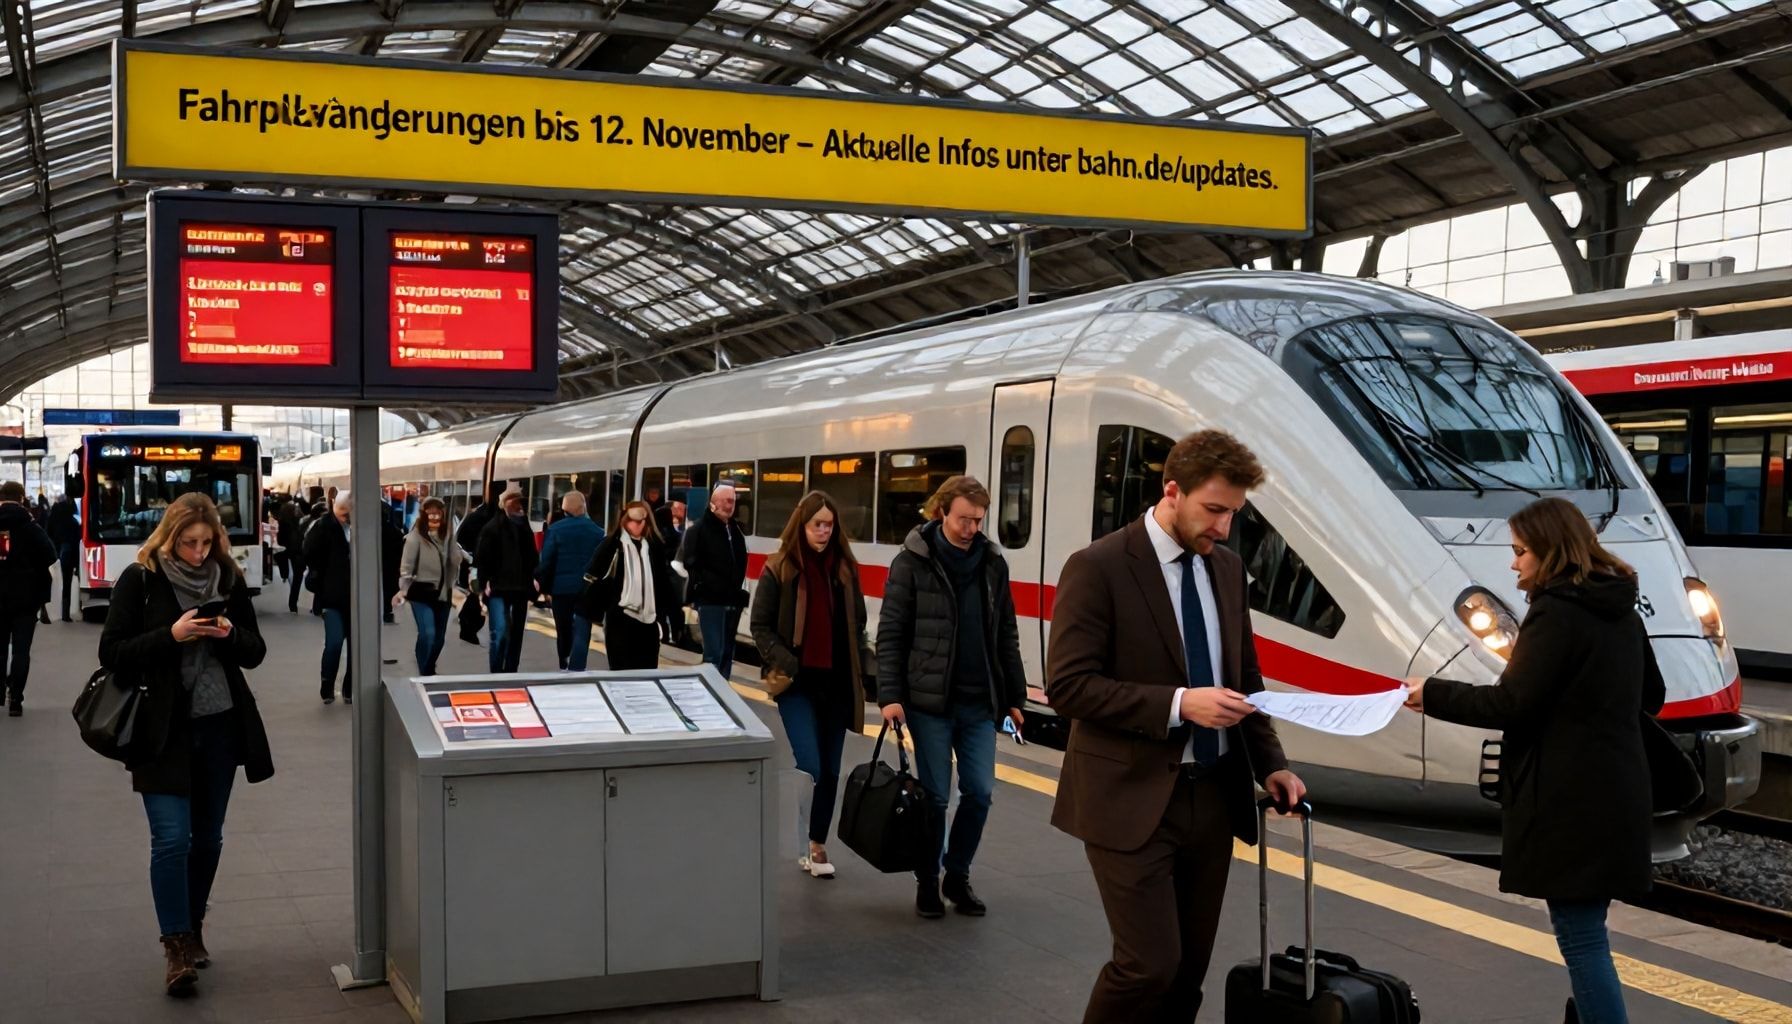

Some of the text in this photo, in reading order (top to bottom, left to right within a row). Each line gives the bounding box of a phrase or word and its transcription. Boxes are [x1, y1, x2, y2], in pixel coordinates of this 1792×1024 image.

[535, 108, 580, 143] bis
[590, 114, 634, 146] 12.
[643, 116, 791, 154] November
[822, 128, 931, 164] Aktuelle
[938, 136, 1000, 169] Infos
[1006, 146, 1073, 173] unter
[1077, 147, 1279, 192] bahn.de/updates.
